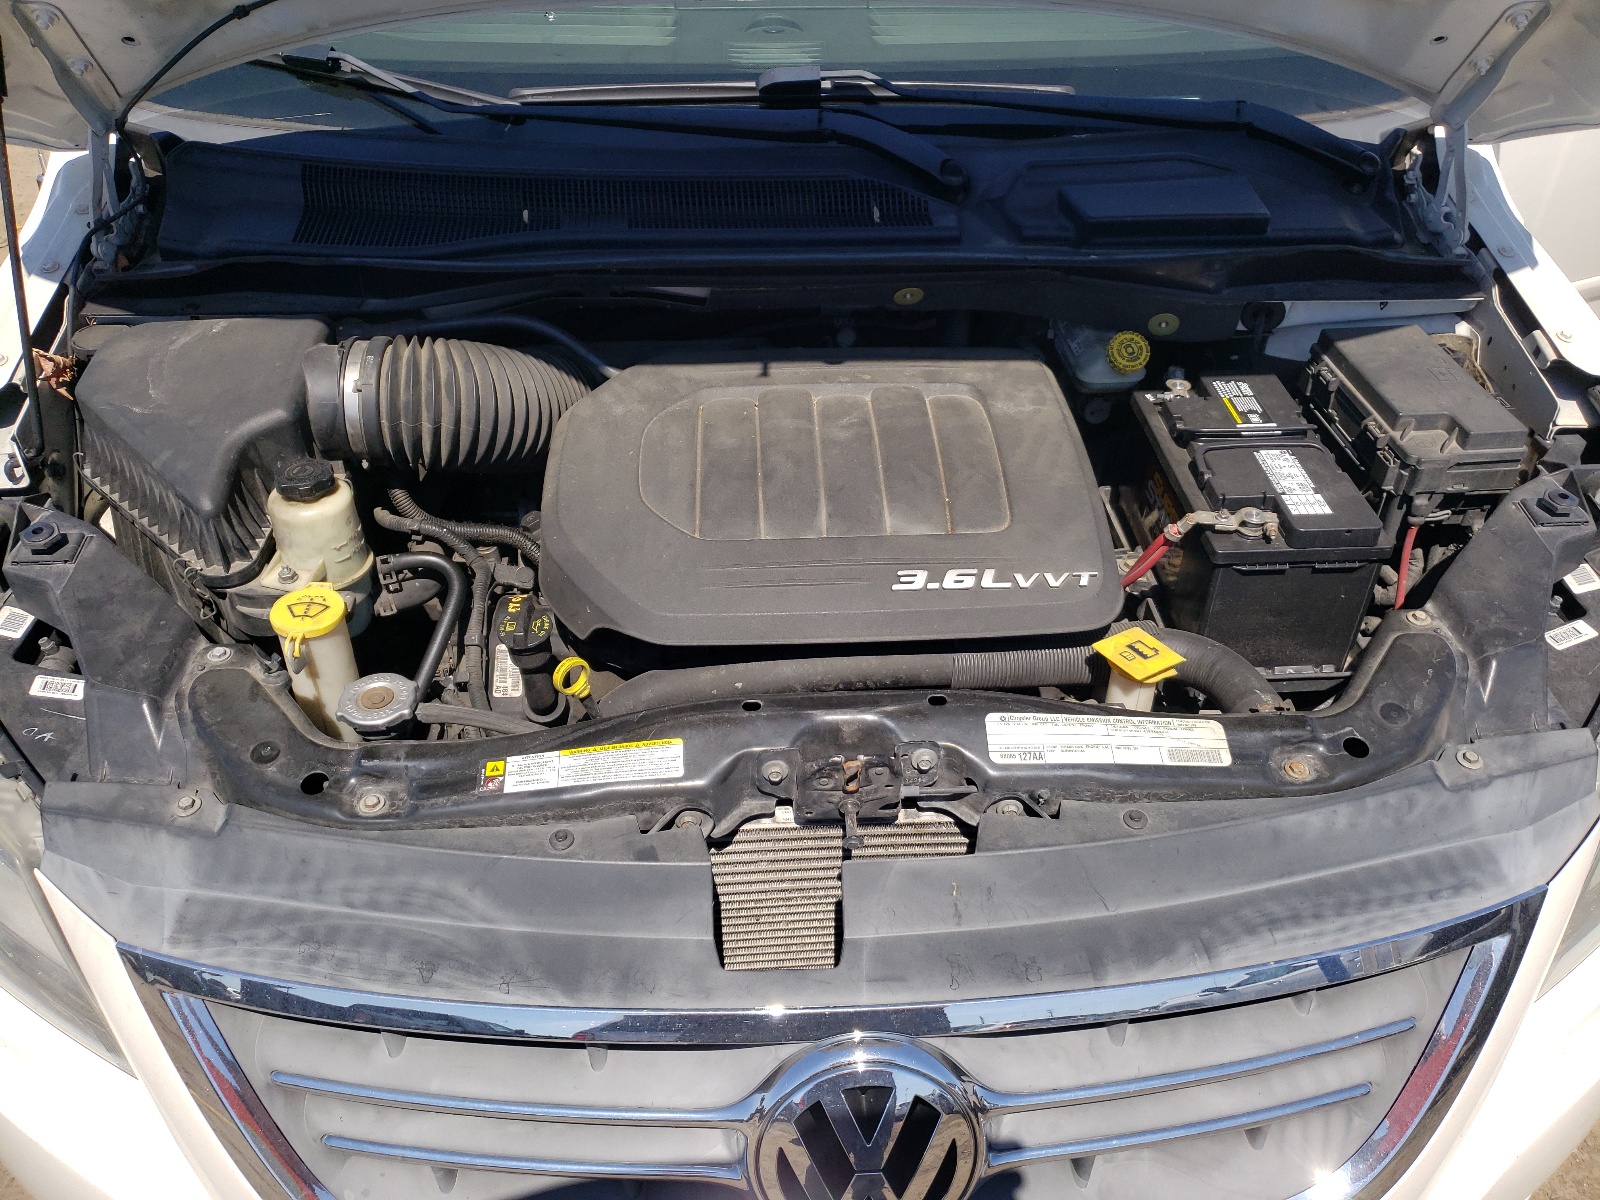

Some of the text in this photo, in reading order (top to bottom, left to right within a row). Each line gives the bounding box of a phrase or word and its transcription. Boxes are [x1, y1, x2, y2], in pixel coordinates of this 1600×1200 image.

[891, 568, 1099, 591] 3.6L VVT
[1018, 752, 1044, 761] 127AA
